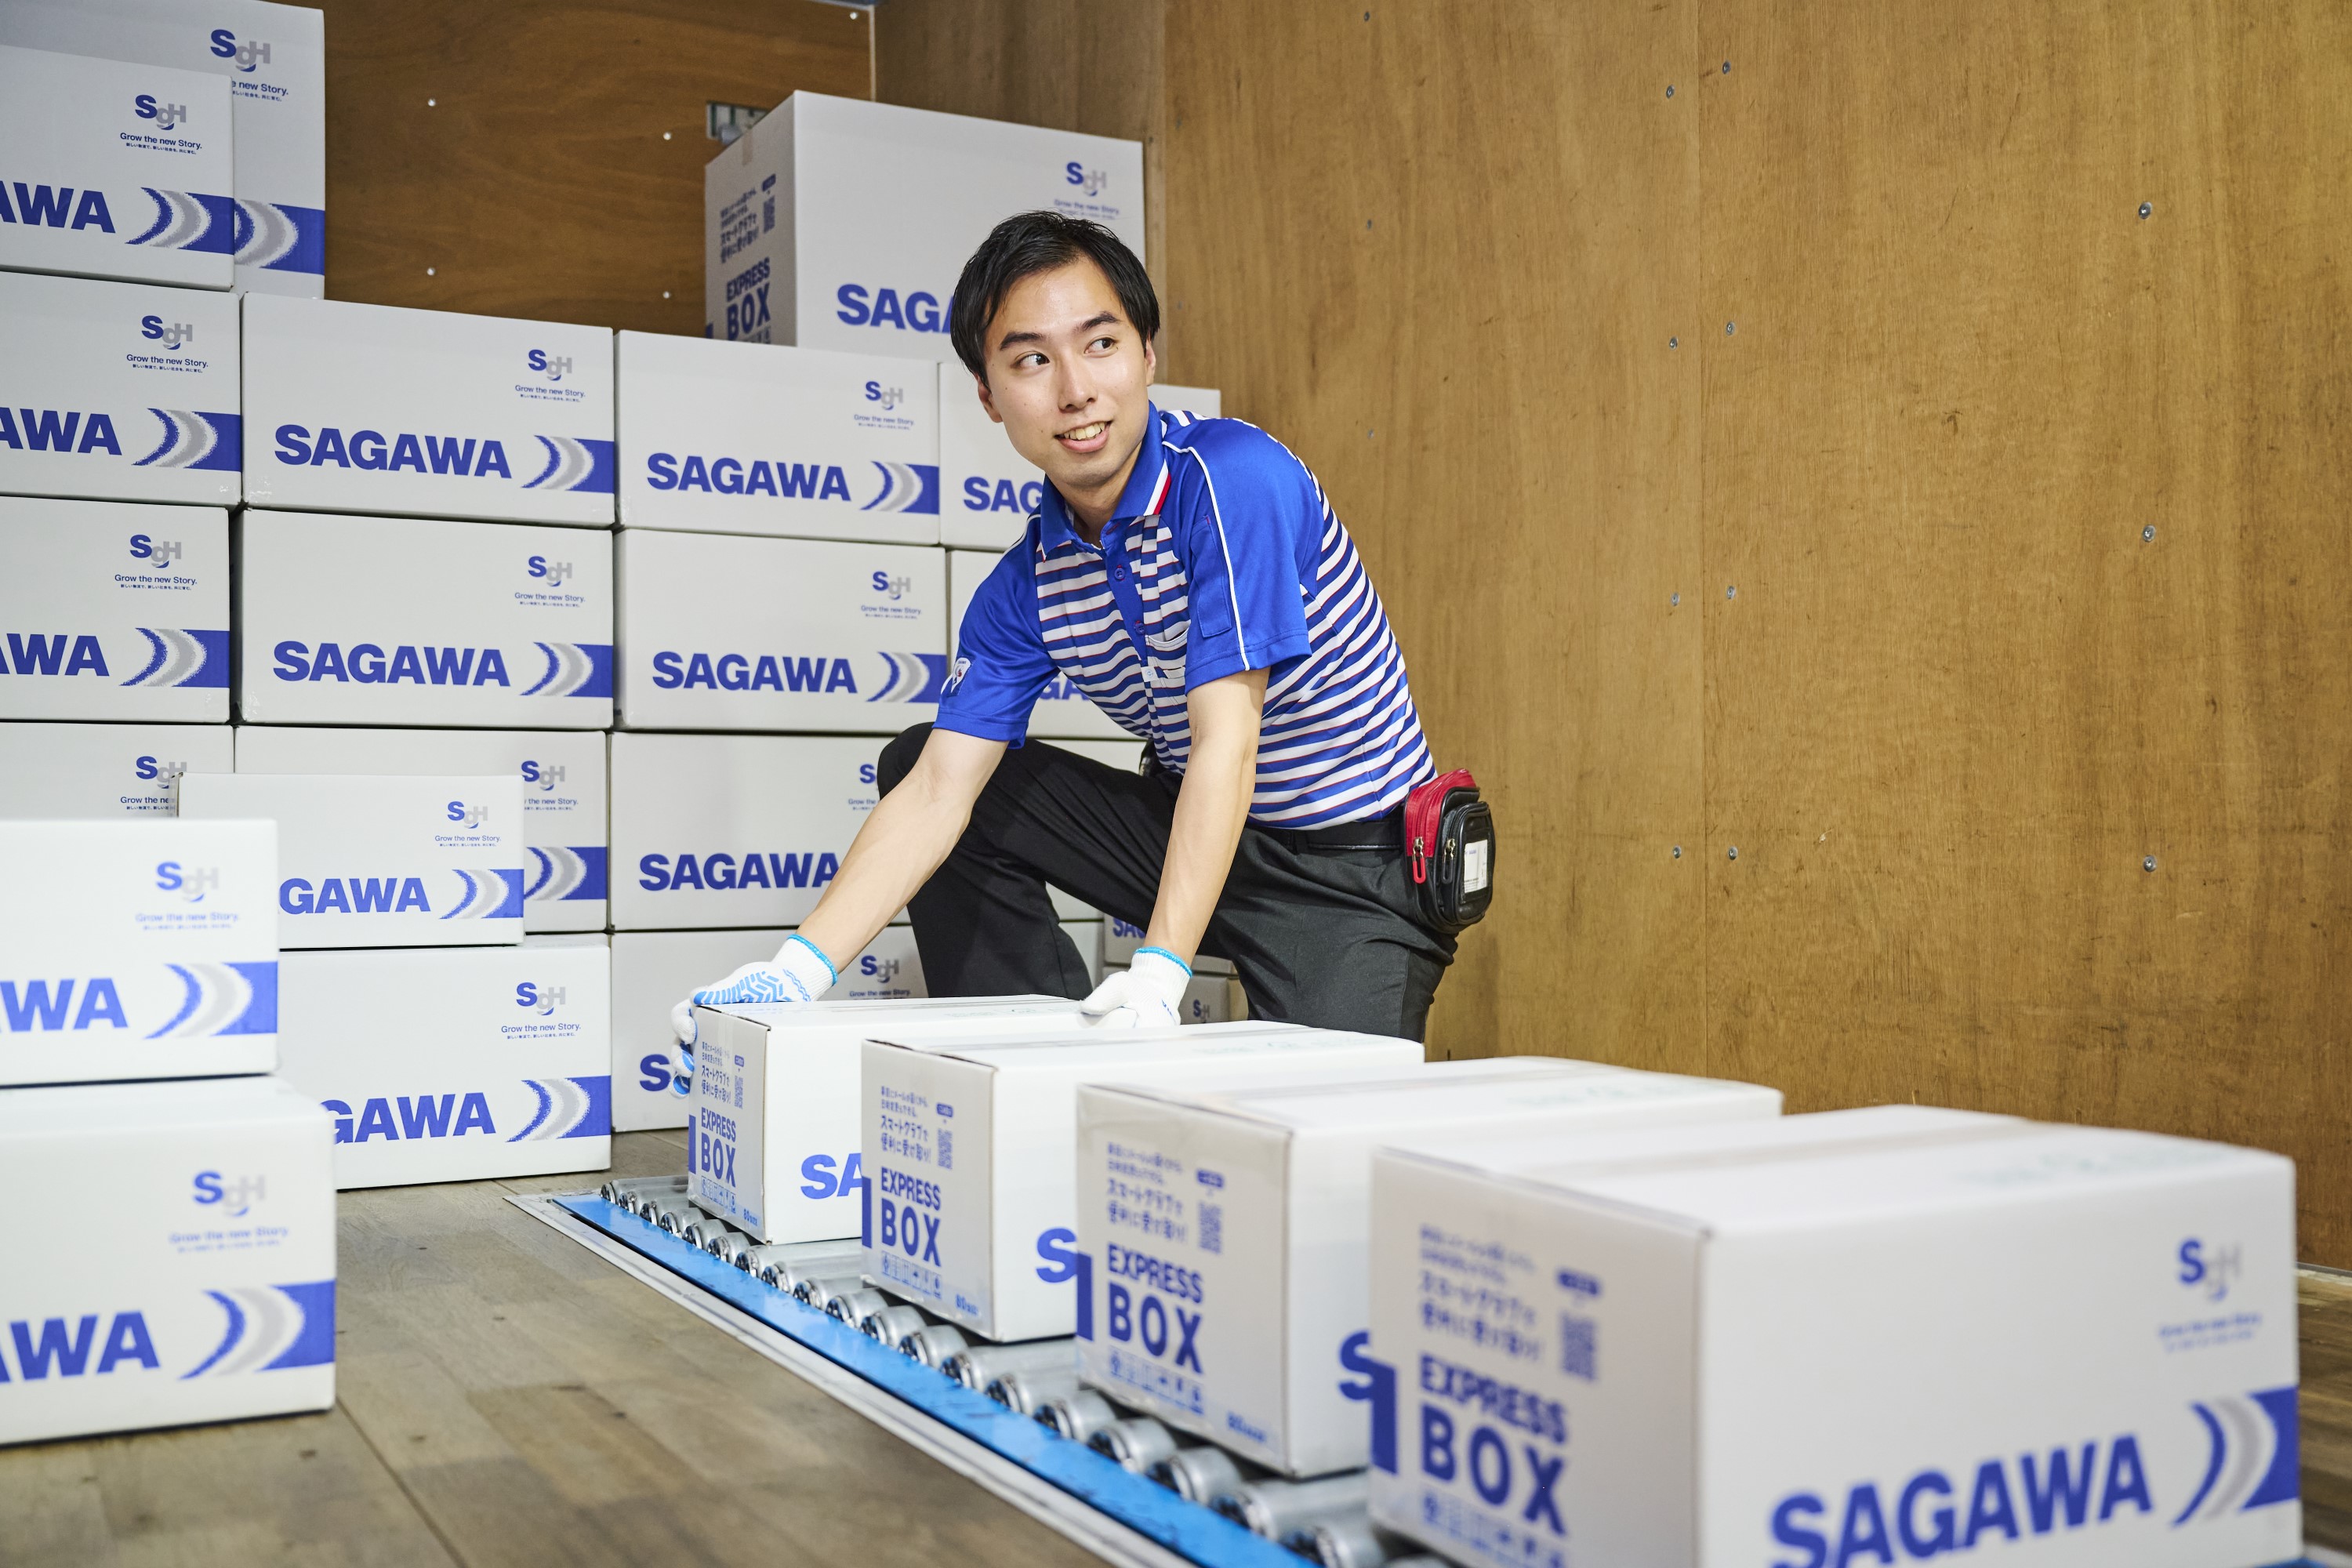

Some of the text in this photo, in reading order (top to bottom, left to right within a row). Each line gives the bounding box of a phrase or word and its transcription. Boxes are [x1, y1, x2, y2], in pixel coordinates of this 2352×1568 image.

[210, 29, 270, 72] SgH
[238, 82, 259, 90] new
[260, 83, 289, 96] Story.
[135, 94, 187, 131] SgH
[120, 132, 142, 142] Grow
[178, 140, 202, 150] Story.
[726, 256, 770, 303] EXPRESS
[727, 281, 771, 341] BOX
[837, 283, 952, 333] SAG
[141, 315, 193, 350] SgH
[126, 354, 148, 362] Grow
[184, 358, 209, 368] Story.
[528, 349, 572, 381] SgH
[564, 389, 586, 398] Story.
[274, 424, 512, 479] SAGAWA
[647, 452, 851, 502] SAGAWA
[129, 534, 181, 568] SgH
[528, 556, 572, 587] SgH
[173, 576, 198, 586] Story.
[564, 594, 586, 603] Story.
[0, 633, 110, 677] WA
[273, 641, 510, 687] SAGAWA
[652, 651, 858, 694] SAGAWA
[557, 797, 579, 806] Story.
[639, 852, 840, 891] SAGAWA
[0, 978, 129, 1033] WA
[516, 982, 566, 1016] SgH
[557, 1022, 582, 1032] Story.
[701, 1106, 736, 1143] EXPRESS
[701, 1132, 736, 1188] BOX
[880, 1166, 941, 1211] EXPRESS
[880, 1197, 942, 1267] BOX
[1107, 1243, 1203, 1304] EXPRESS
[0, 1311, 161, 1384] WA
[1108, 1282, 1203, 1374] BOX
[1421, 1354, 1566, 1444] EXPRESS
[1421, 1403, 1566, 1536] BOX
[1770, 1434, 2153, 1568] SAGAWA
